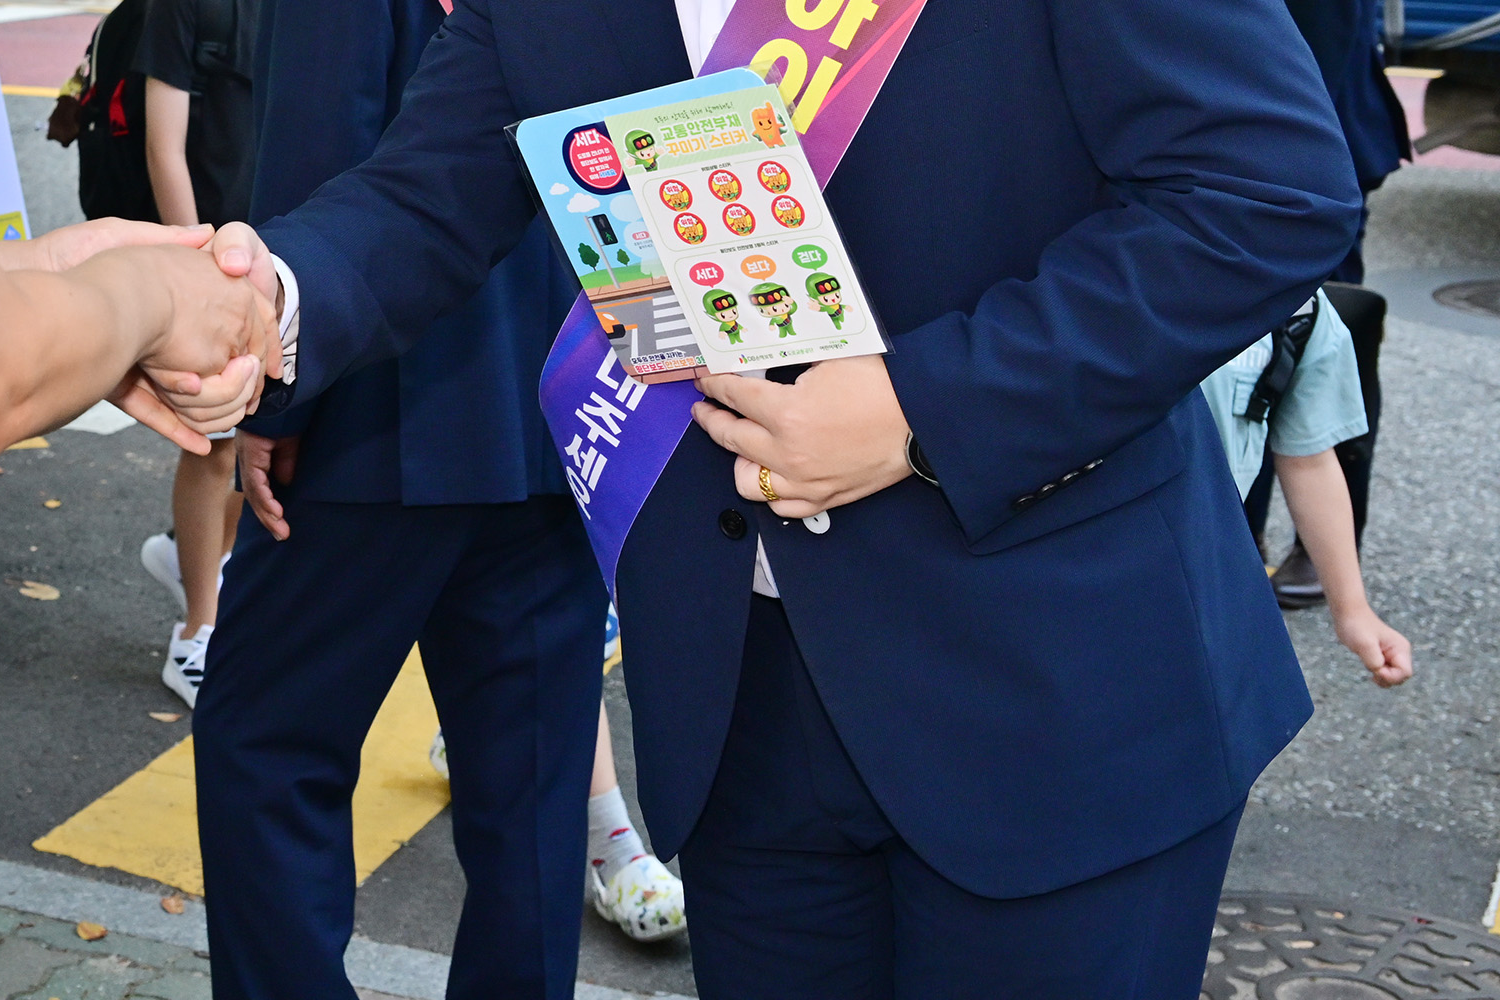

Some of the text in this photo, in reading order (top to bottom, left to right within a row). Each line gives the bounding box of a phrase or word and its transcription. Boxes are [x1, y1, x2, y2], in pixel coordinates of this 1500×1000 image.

[659, 113, 742, 141] 교통안전부채
[574, 128, 601, 147] 서다
[665, 129, 749, 156] 꾸미기 스티커
[797, 250, 822, 264] 걷다
[695, 267, 719, 280] 서다
[746, 260, 771, 274] 보다
[635, 362, 666, 373] 횡단보도
[564, 346, 649, 520] 내주세요
